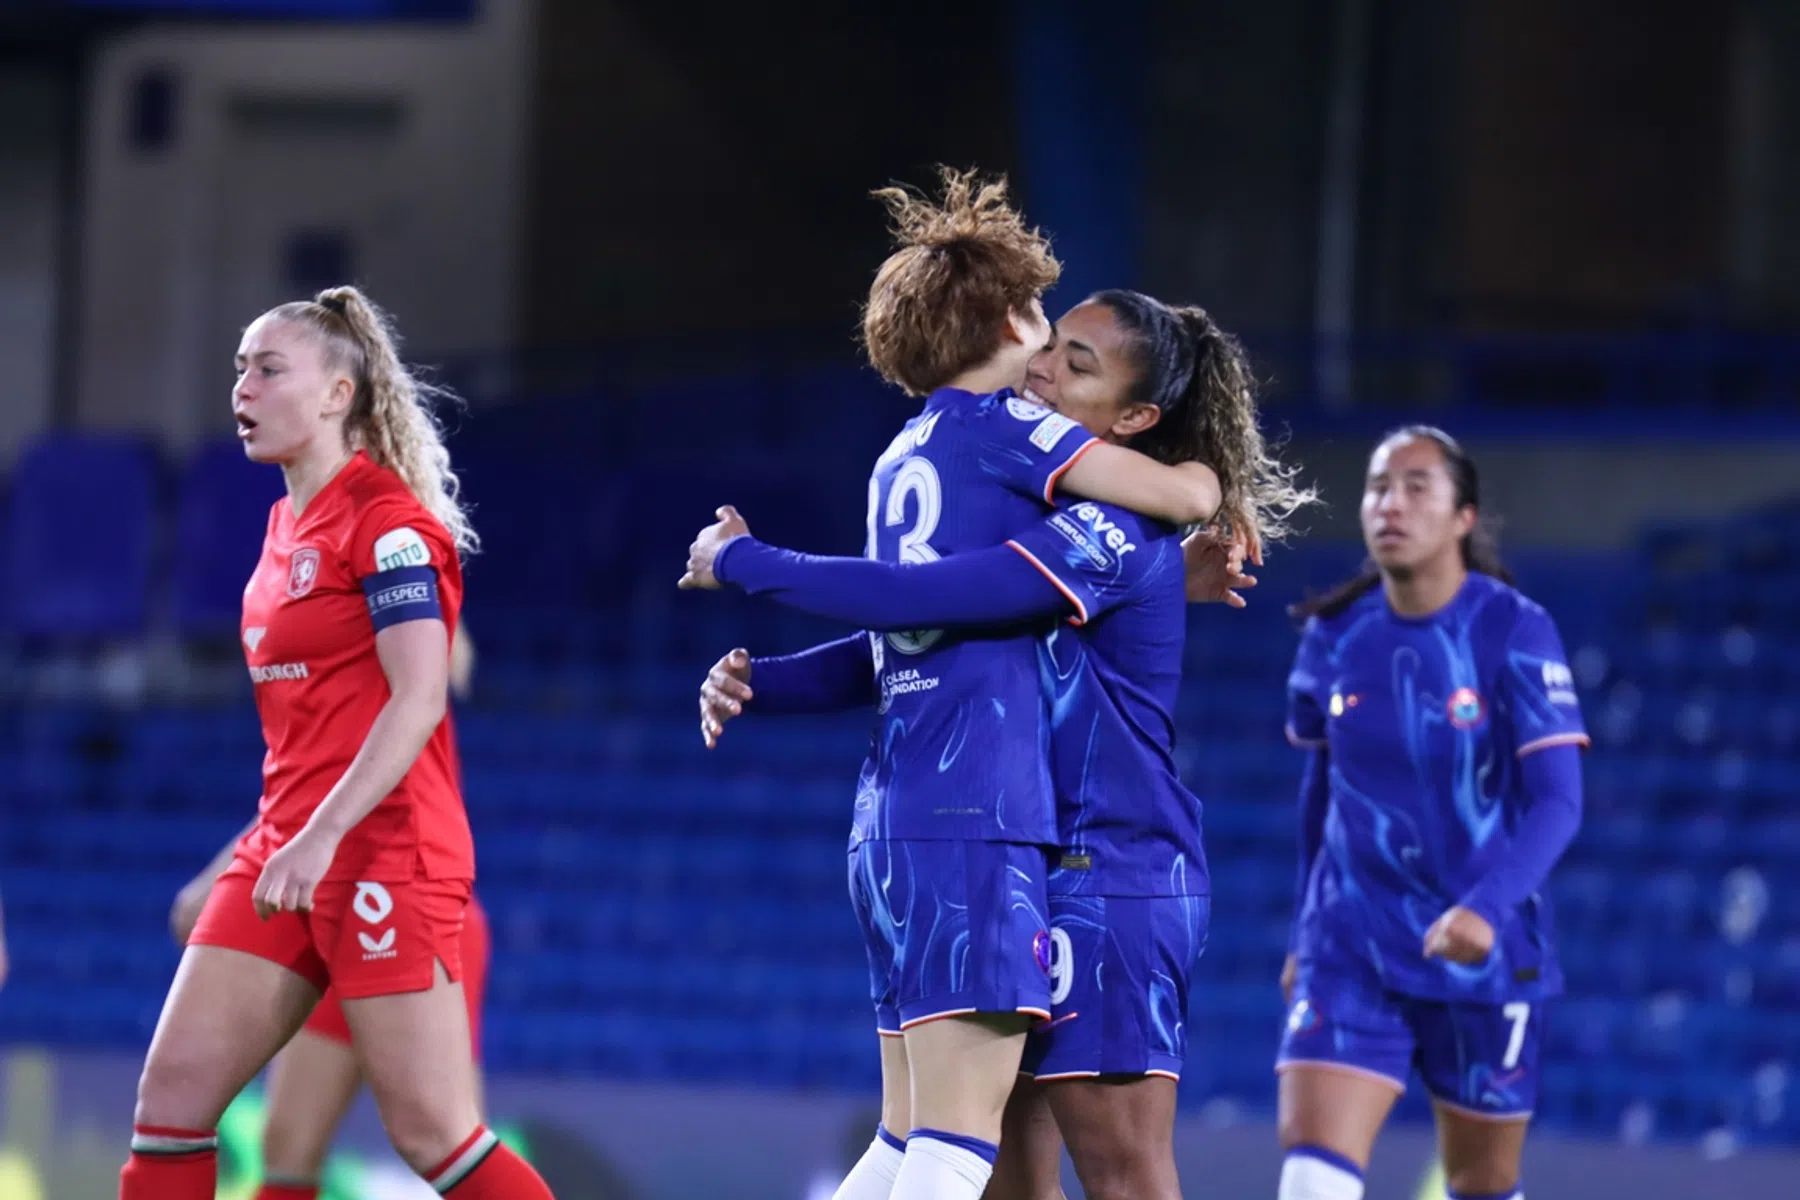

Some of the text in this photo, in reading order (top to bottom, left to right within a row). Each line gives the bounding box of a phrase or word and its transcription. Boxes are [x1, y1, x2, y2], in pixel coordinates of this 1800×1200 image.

[380, 543, 422, 570] TOTO
[376, 586, 428, 606] RESPECT
[1503, 1002, 1530, 1069] 7
